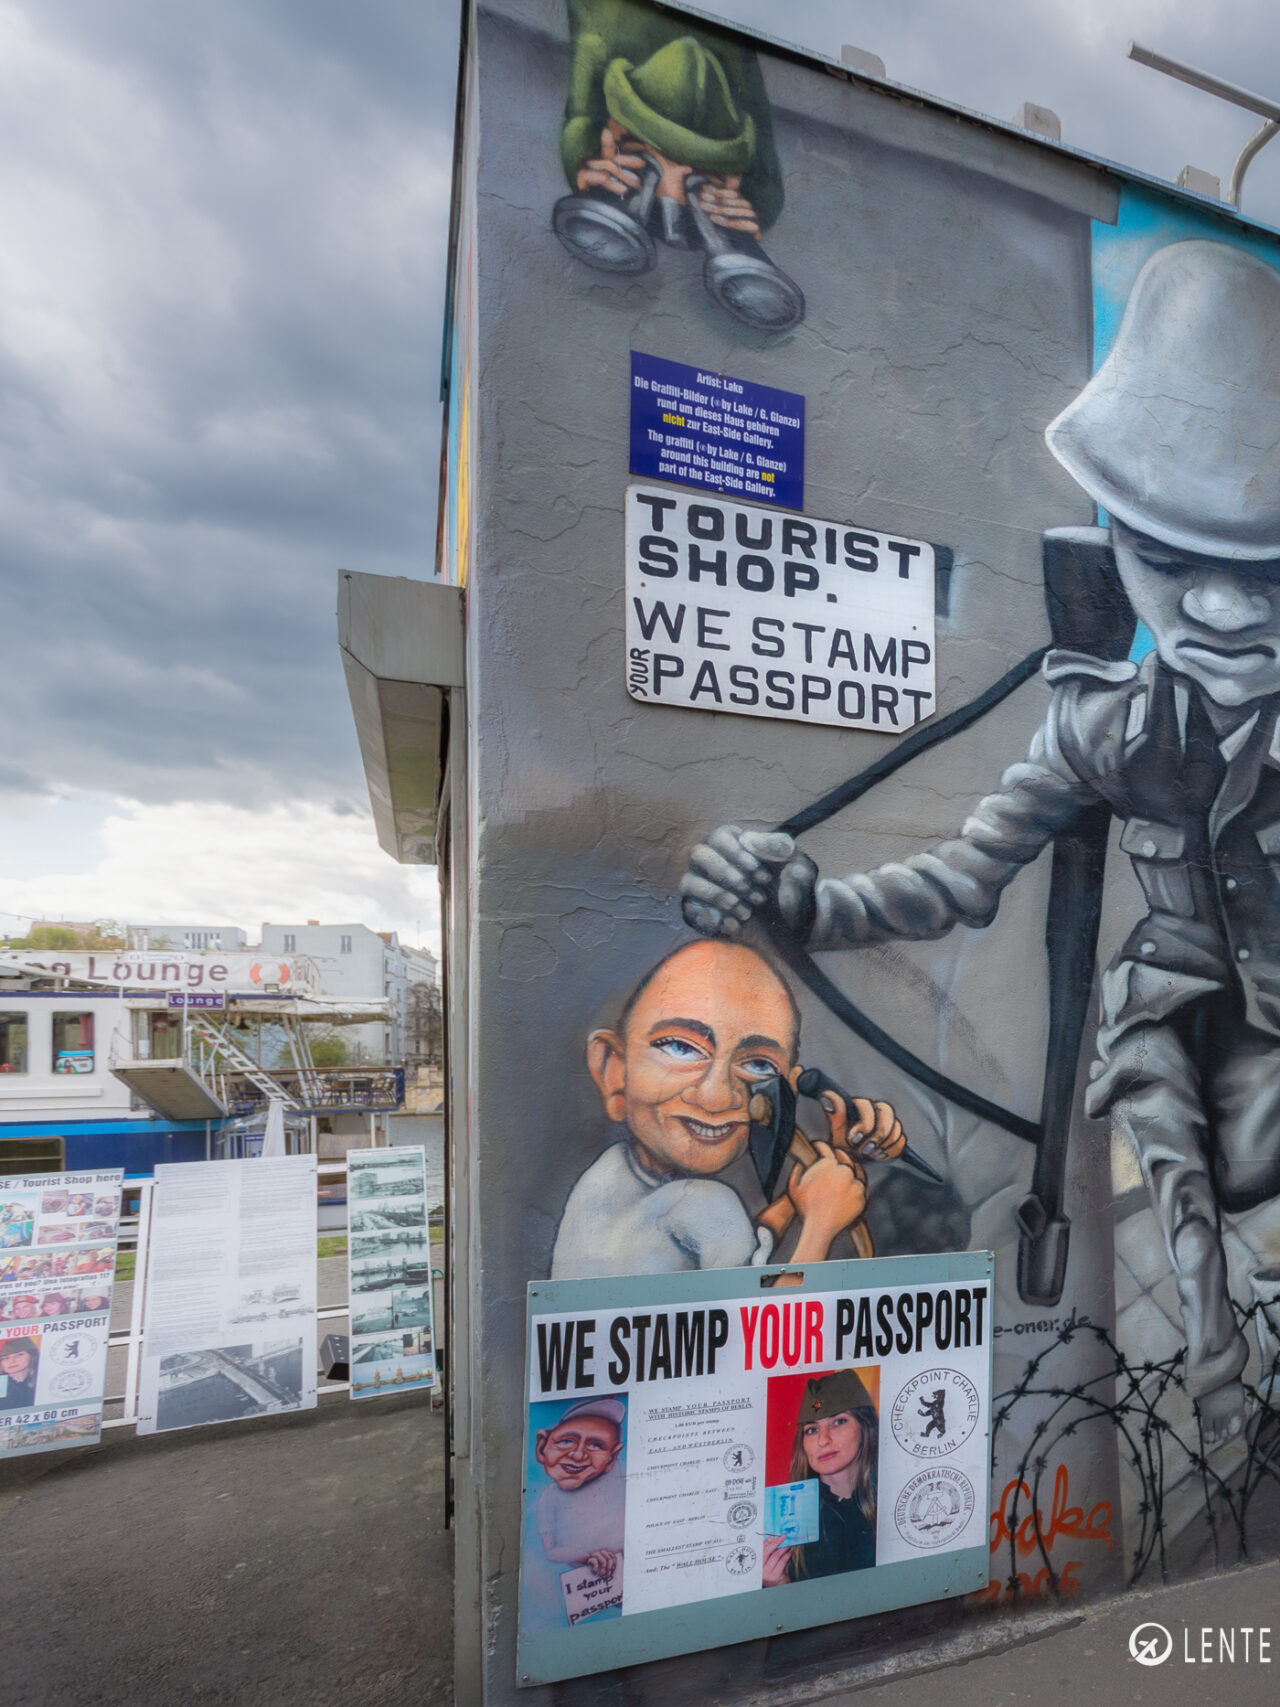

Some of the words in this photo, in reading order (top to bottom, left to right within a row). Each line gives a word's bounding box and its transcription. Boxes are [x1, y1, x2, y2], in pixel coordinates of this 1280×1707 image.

[697, 373, 722, 389] Artist:
[723, 378, 744, 394] Lake
[634, 376, 649, 390] Die
[651, 381, 708, 404] Graffiti-Bilder
[733, 402, 753, 417] Lake
[760, 408, 769, 421] G.
[770, 411, 800, 429] Glanze)
[657, 398, 677, 410] rund
[679, 403, 693, 415] um
[694, 406, 722, 422] dieses
[724, 414, 745, 428] Haus
[746, 420, 780, 437] gehören
[663, 413, 685, 427] nicht
[686, 419, 701, 431] zur
[702, 422, 741, 441] East-Side
[743, 432, 774, 449] Gallery.
[648, 429, 664, 442] The
[665, 433, 694, 450] graffiti
[719, 446, 739, 462] Lake
[746, 452, 754, 465] G.
[756, 455, 787, 473] Glanze)
[661, 448, 691, 464] around
[693, 453, 709, 467] this
[711, 457, 744, 476] building
[746, 468, 760, 480] are
[761, 471, 775, 483] not
[659, 462, 677, 475] part
[678, 466, 687, 477] of
[688, 468, 703, 481] the
[704, 471, 744, 490] East-Side
[745, 481, 776, 498] Gallery.
[636, 493, 921, 580] TOURIST
[638, 535, 838, 603] SHOP.
[633, 597, 731, 651] WE
[751, 616, 931, 679] STAMP
[629, 648, 651, 697] YOUR
[653, 653, 932, 726] PASSPORT
[88, 956, 229, 987] Lounge
[23, 1178, 61, 1188] Tourist
[64, 1175, 92, 1185] Shop
[96, 1174, 121, 1183] here
[6, 1325, 39, 1338] YOUR
[43, 1316, 108, 1334] PASSPORT
[536, 1318, 596, 1393] WE
[607, 1308, 729, 1386] STAMP
[739, 1300, 825, 1371] YOUR
[835, 1287, 988, 1361] PASSPORT
[16, 1414, 29, 1424] 42
[43, 1410, 57, 1420] 60
[61, 1408, 79, 1417] cm
[661, 1405, 682, 1413] STAMP
[713, 1397, 751, 1407] PASSPORT
[894, 1371, 950, 1431] CHECKPOINT
[952, 1373, 977, 1422] CHARLIE
[912, 1439, 957, 1456] BERLIN
[897, 1490, 913, 1526] DEUTSCHE
[909, 1469, 962, 1491] DEMOKRATISCHE
[959, 1480, 973, 1511] REPUBLIK
[566, 1583, 572, 1594] I
[584, 1585, 613, 1600] your
